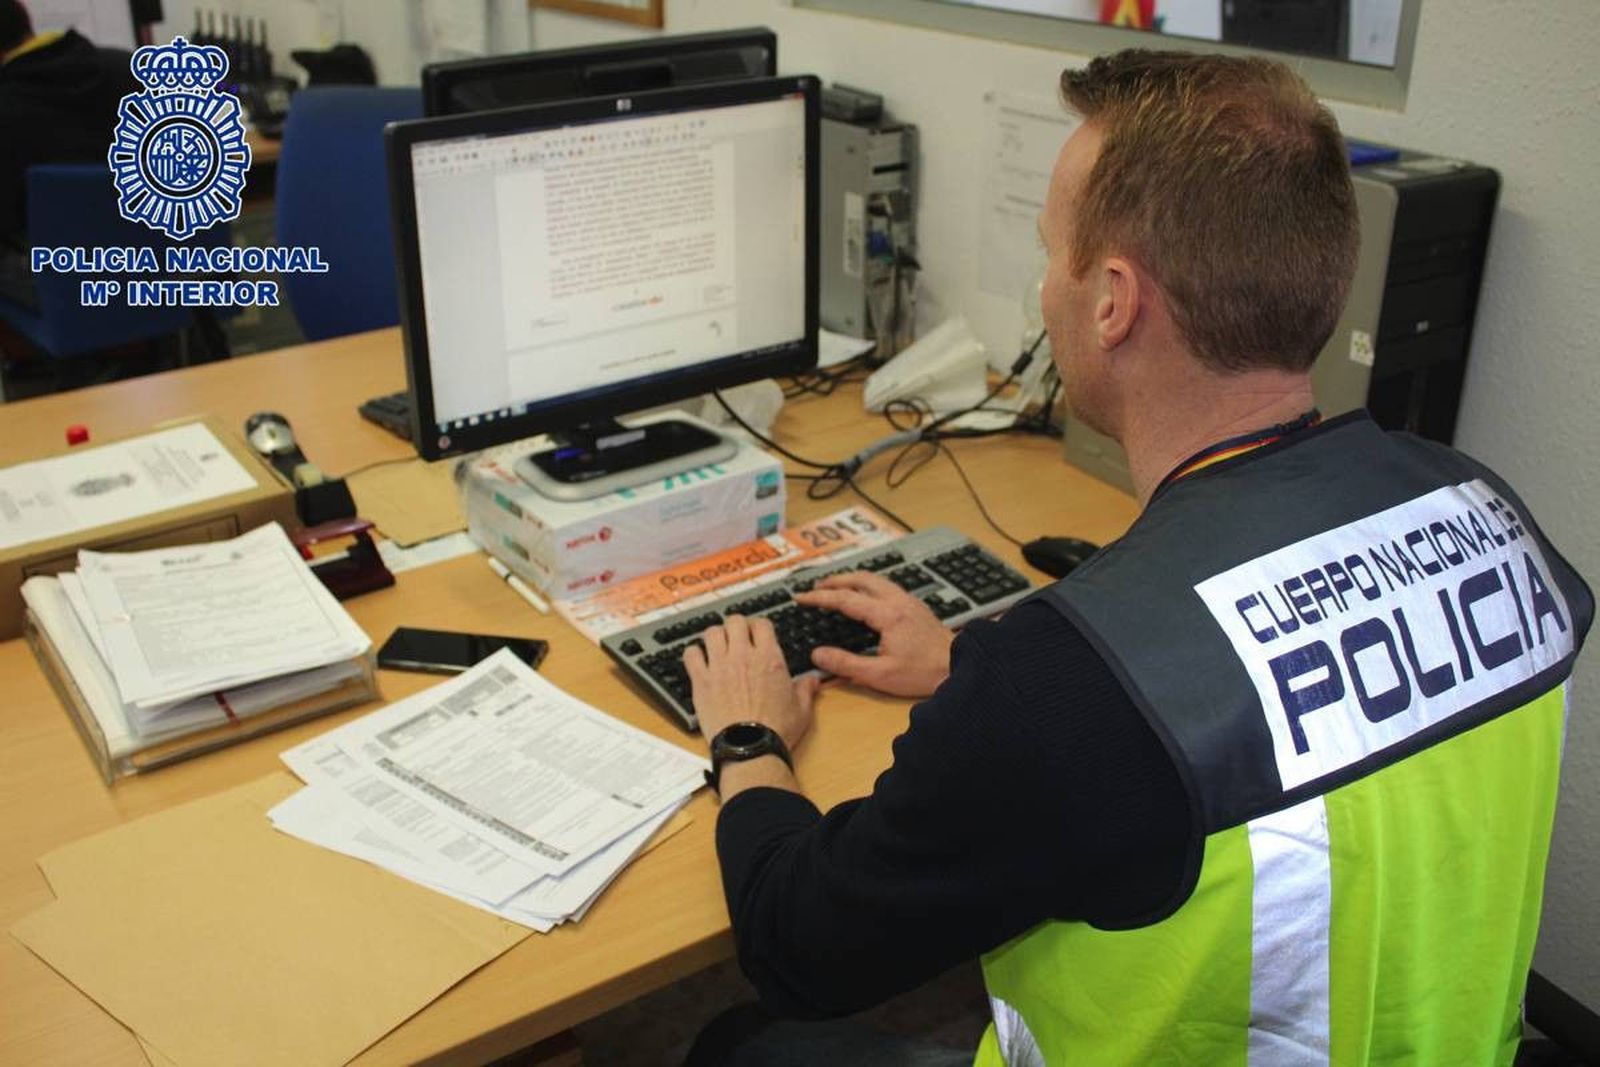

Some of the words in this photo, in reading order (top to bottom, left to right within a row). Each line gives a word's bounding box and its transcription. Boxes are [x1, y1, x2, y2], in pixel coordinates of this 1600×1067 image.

[801, 513, 878, 548] 2015
[1235, 554, 1382, 644] CUERPO
[1369, 506, 1507, 592] NACIONAL
[1268, 552, 1567, 756] POLICIA
